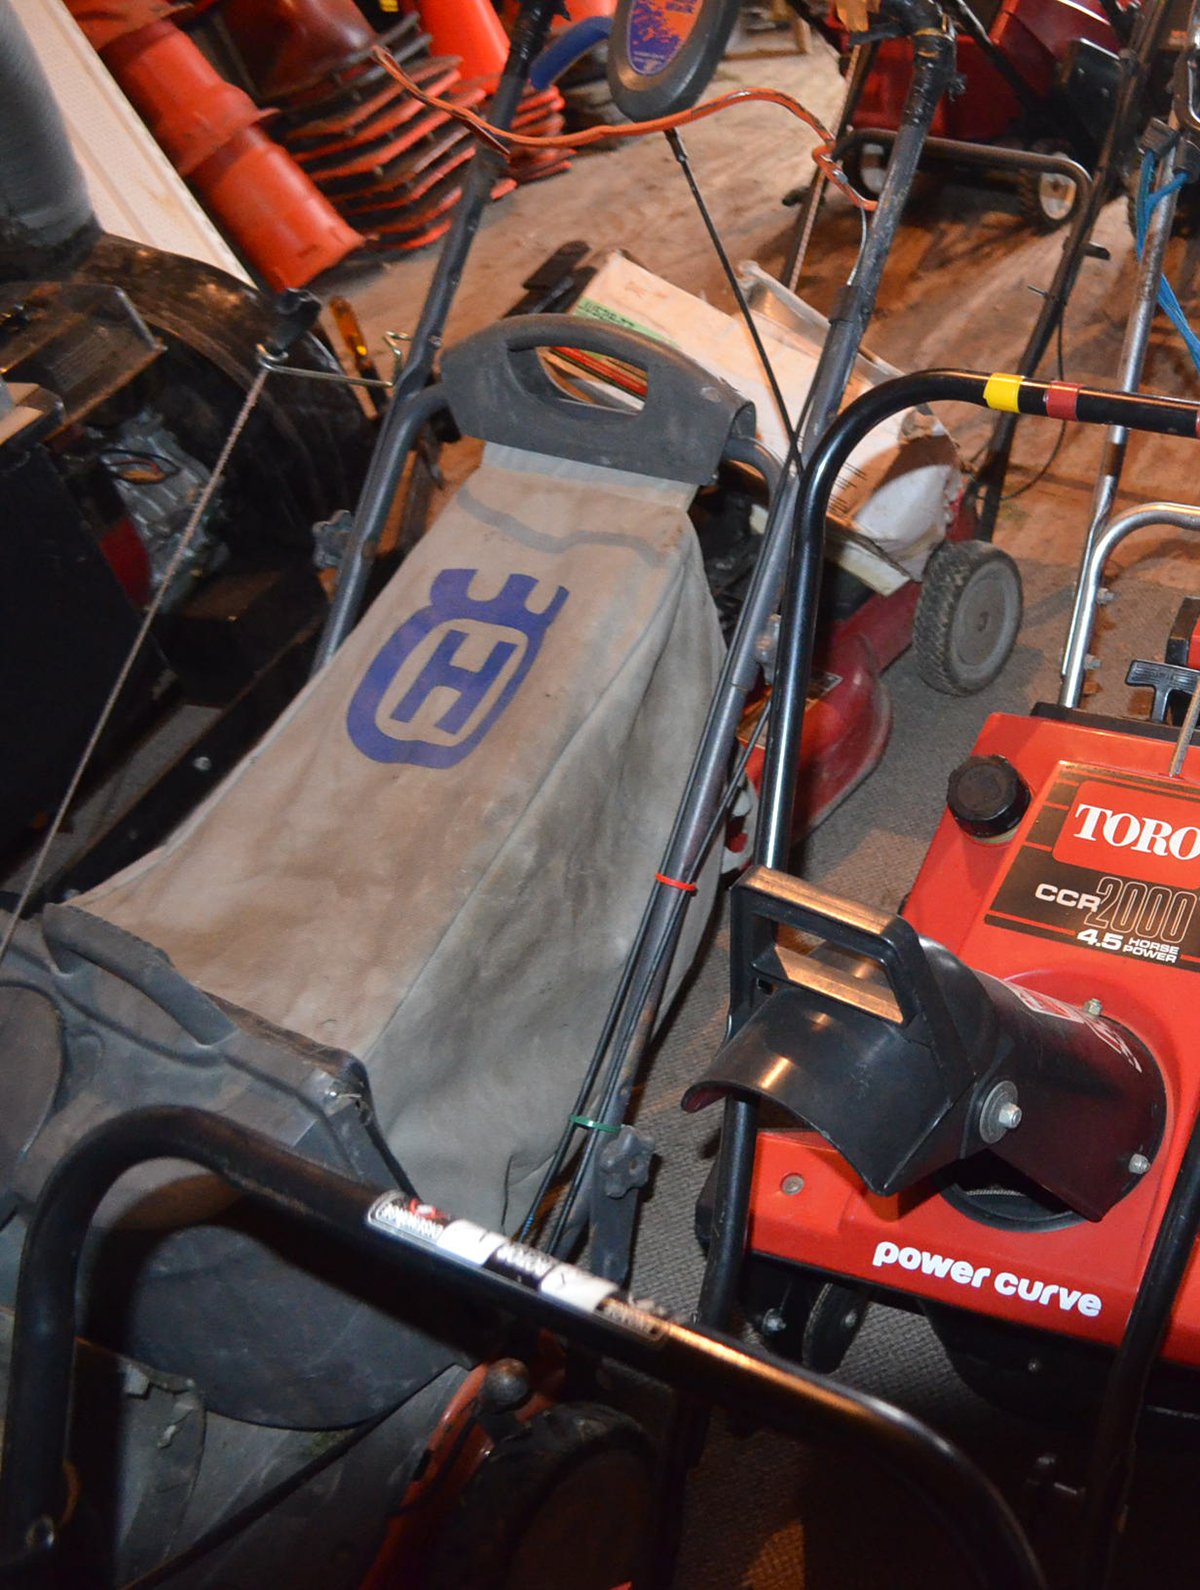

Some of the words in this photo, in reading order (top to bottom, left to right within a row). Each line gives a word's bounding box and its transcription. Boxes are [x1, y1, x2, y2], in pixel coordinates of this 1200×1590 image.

[1035, 883, 1103, 913] CCR
[1084, 876, 1199, 944] 2000
[1077, 928, 1125, 951] 4.5
[1127, 938, 1181, 955] HORSE
[1122, 944, 1178, 964] POWER
[872, 1241, 993, 1289] power
[993, 1271, 1103, 1318] curve
